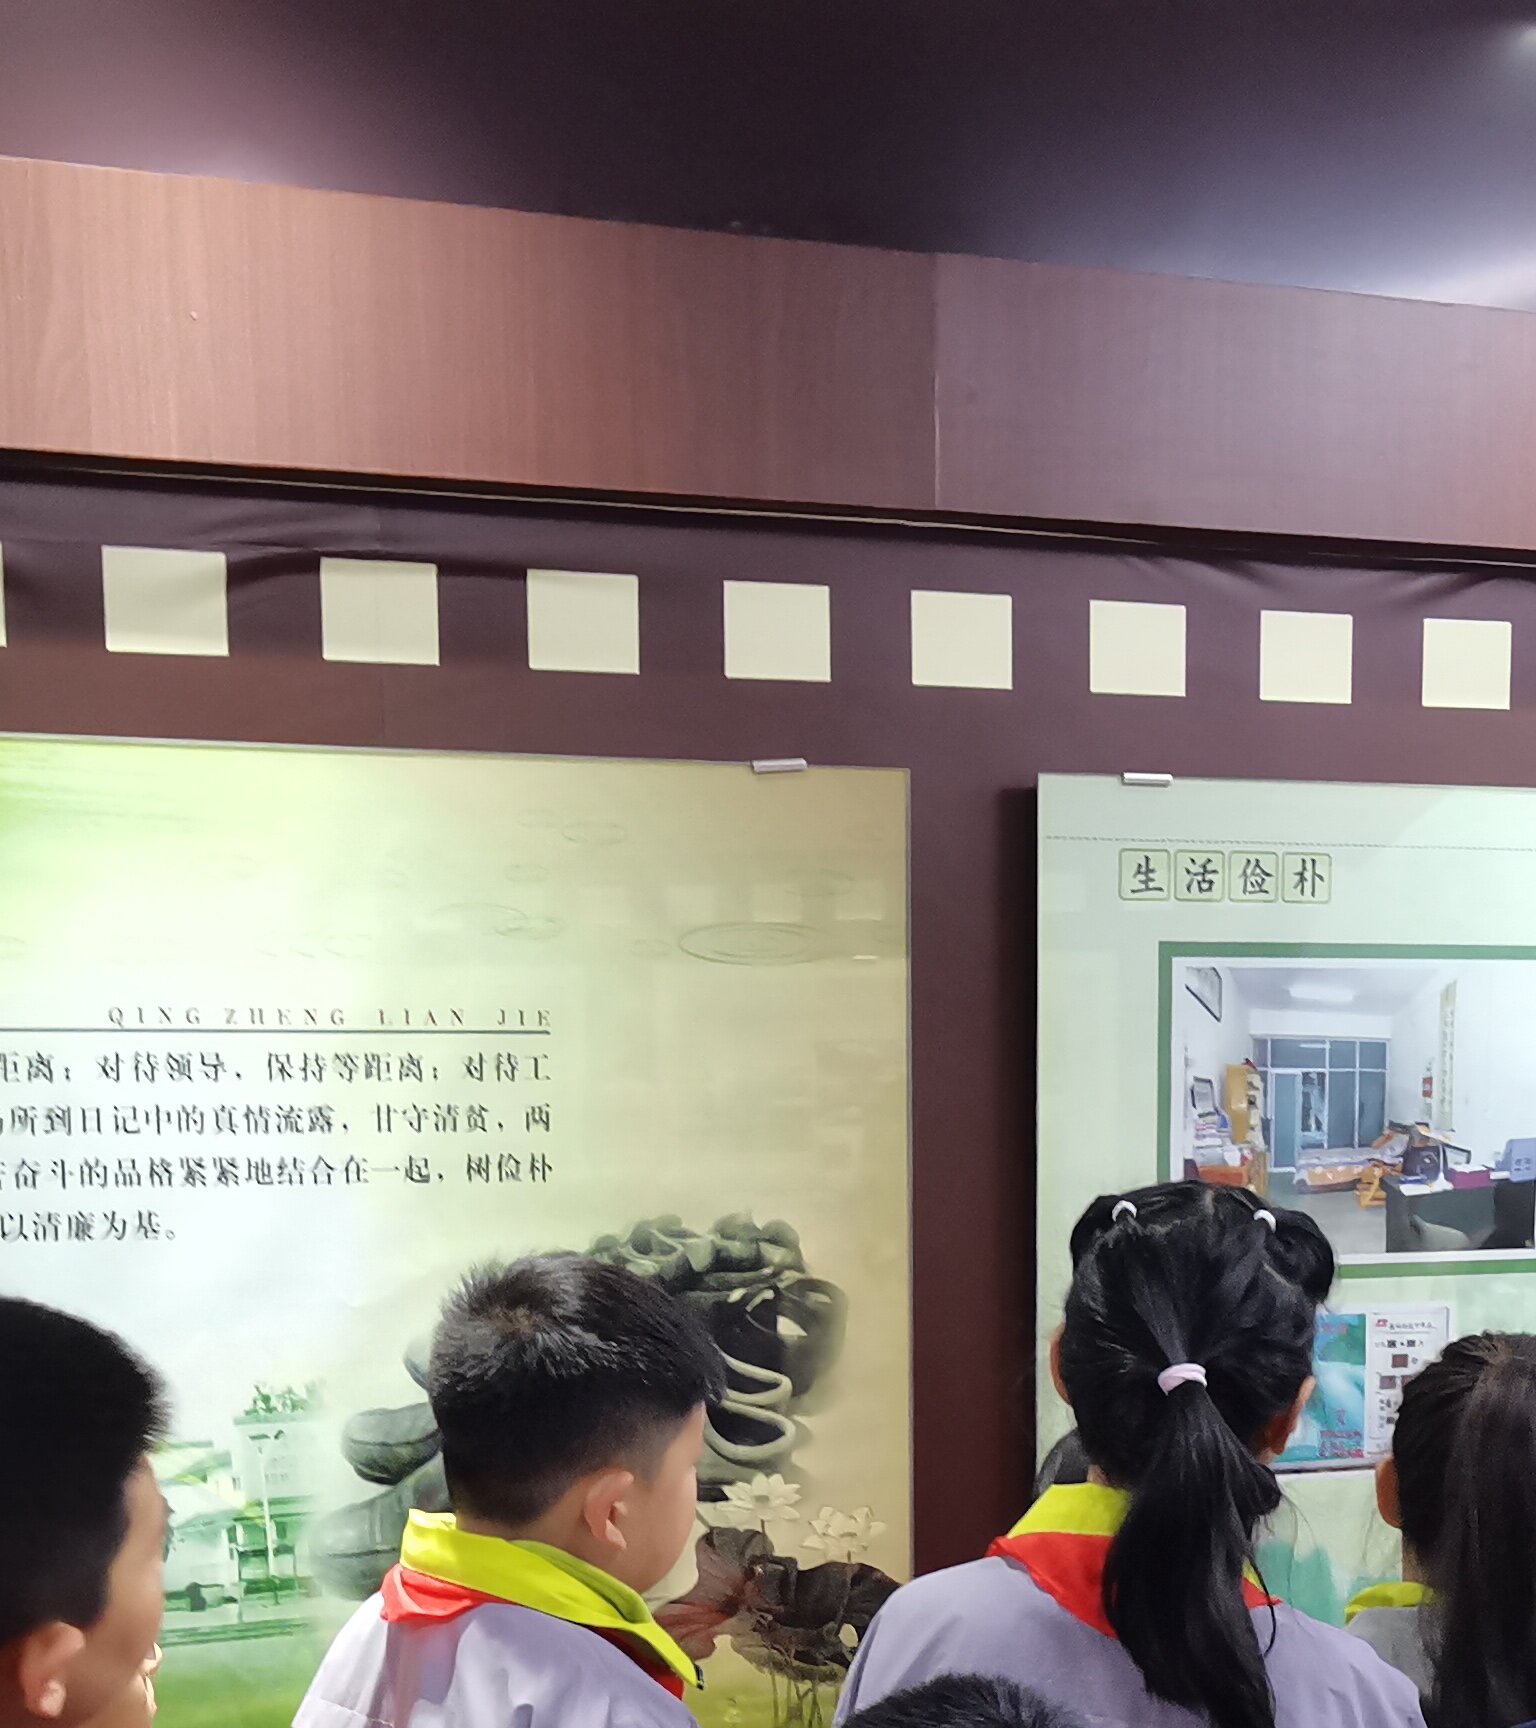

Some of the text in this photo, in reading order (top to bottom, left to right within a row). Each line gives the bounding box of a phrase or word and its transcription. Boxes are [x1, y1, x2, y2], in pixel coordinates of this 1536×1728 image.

[1129, 854, 1326, 899] 生活俭朴
[107, 1006, 551, 1028] QING ZHENG LIAN JIE
